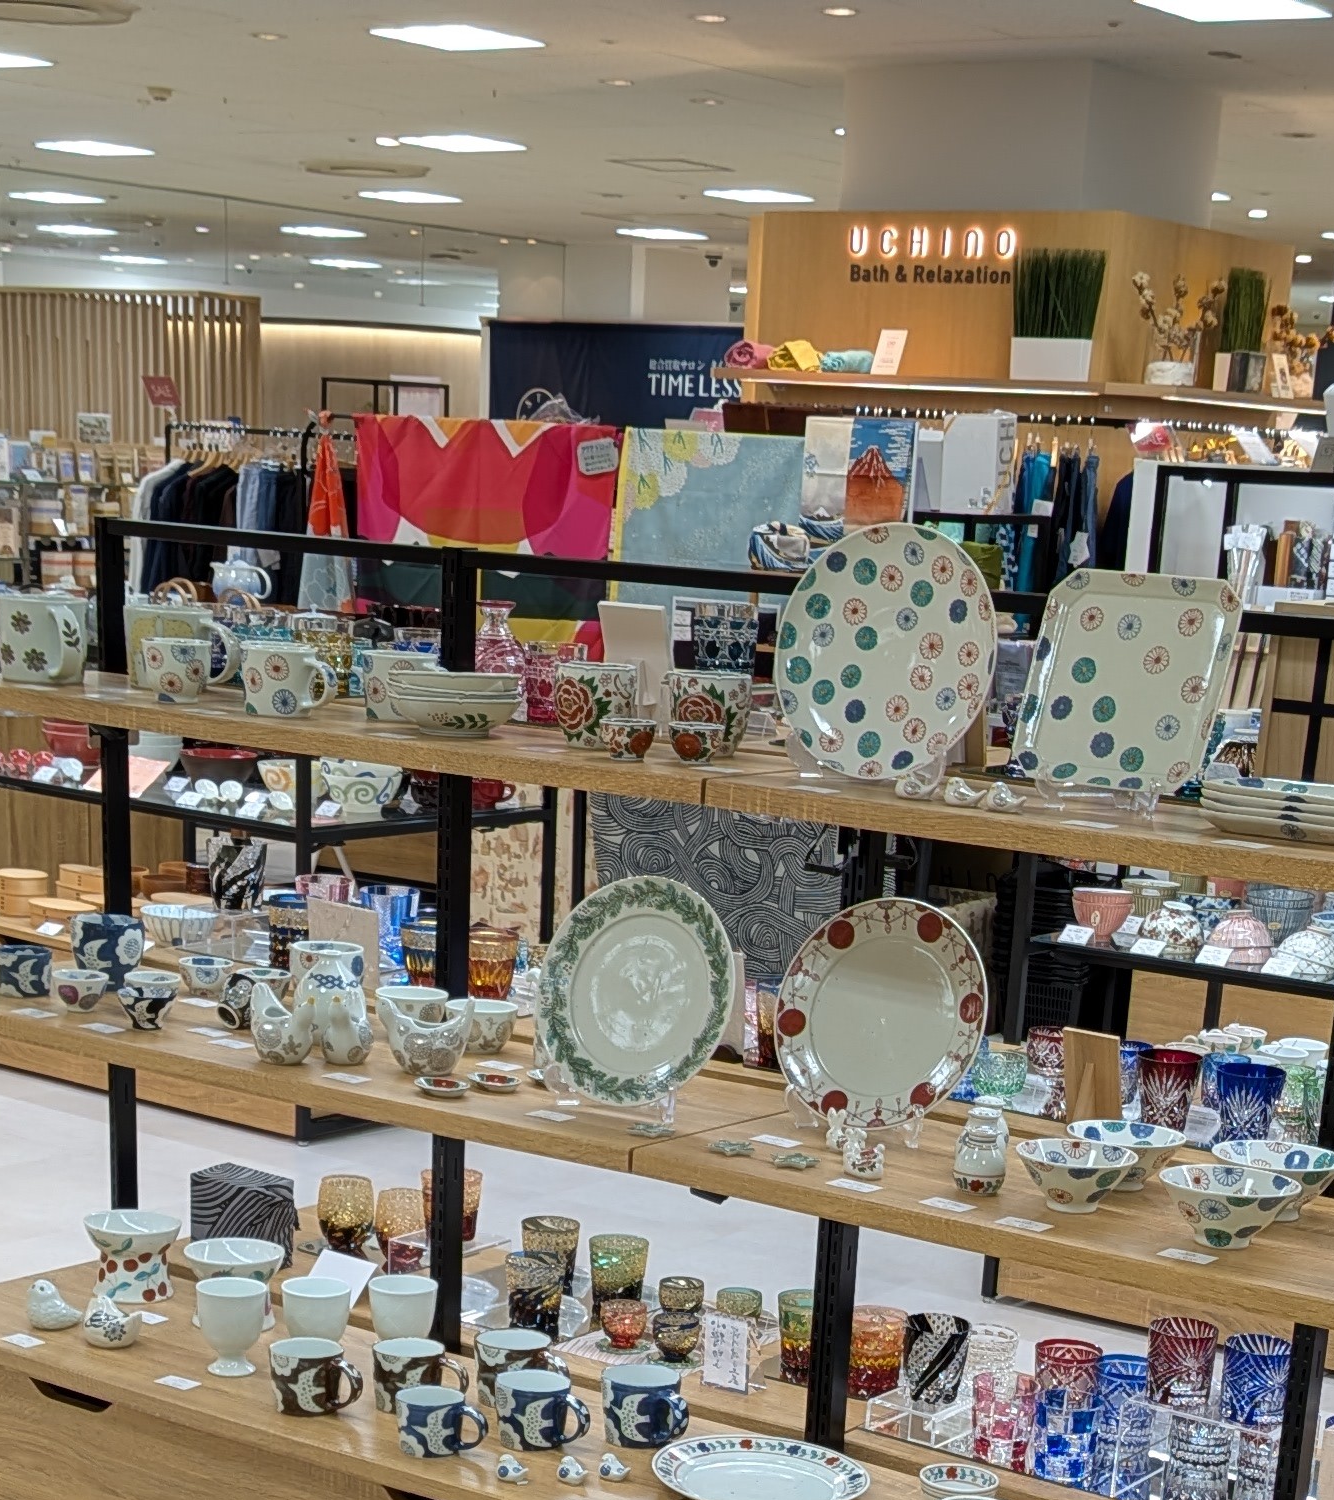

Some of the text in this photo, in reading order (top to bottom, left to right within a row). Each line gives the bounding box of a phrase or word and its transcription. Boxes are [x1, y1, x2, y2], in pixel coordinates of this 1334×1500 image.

[850, 264, 1011, 284] Bath & Relaxation
